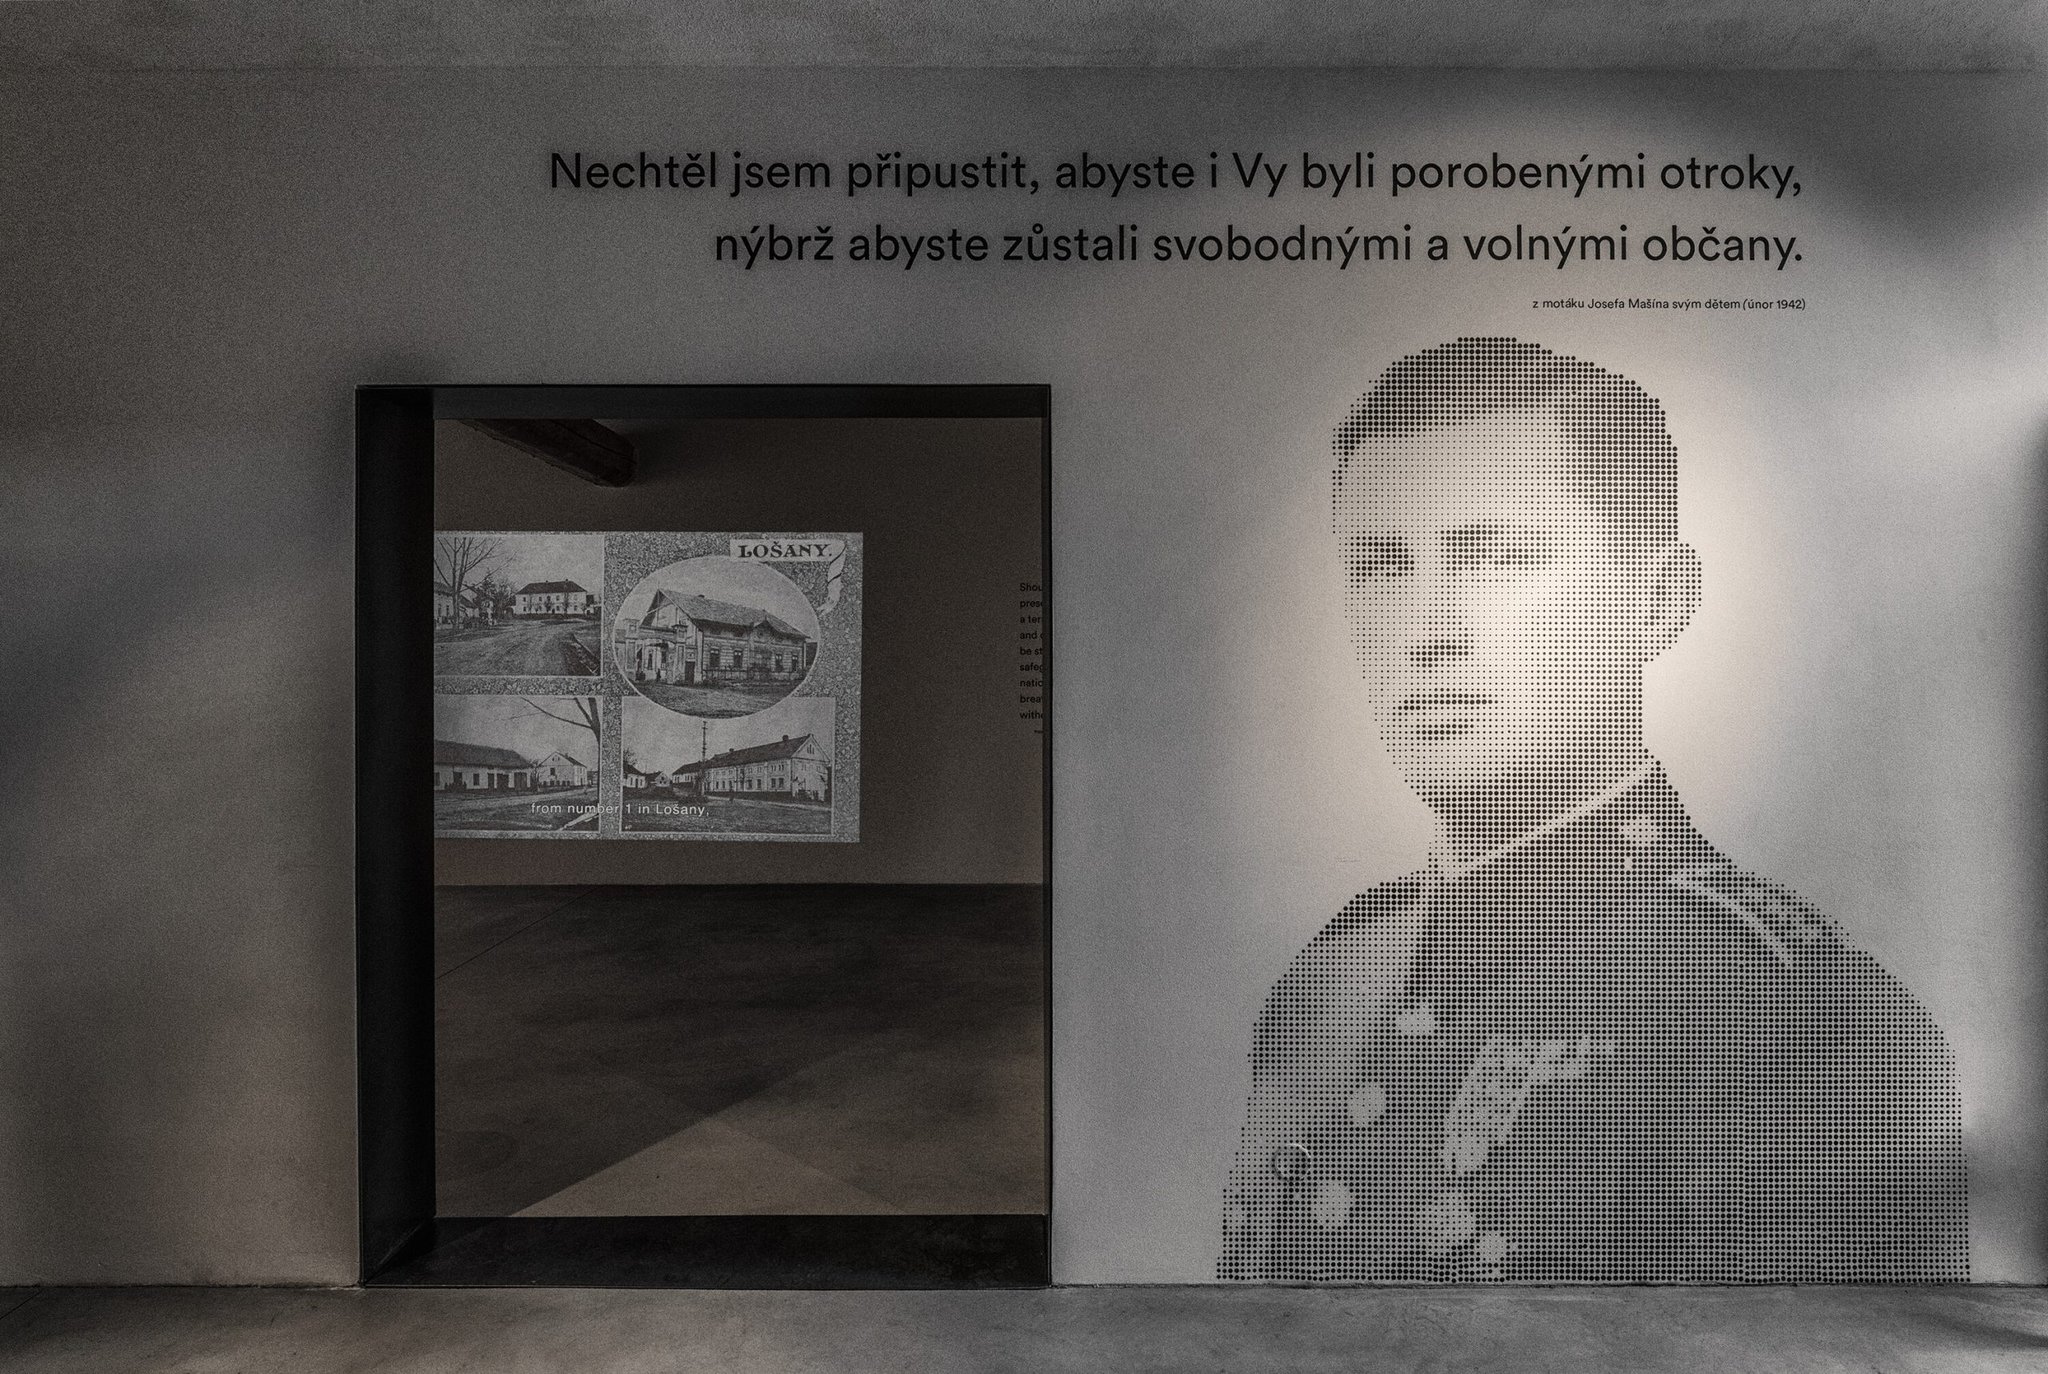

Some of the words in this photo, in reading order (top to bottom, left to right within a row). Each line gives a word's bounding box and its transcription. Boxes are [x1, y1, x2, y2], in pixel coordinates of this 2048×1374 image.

[551, 152, 716, 188] Nechtěl
[730, 152, 830, 197] jsem
[848, 152, 1039, 197] připustit,
[1055, 152, 1195, 197] abyste
[1209, 151, 1218, 188] i
[1232, 153, 1288, 197] Vy
[1303, 152, 1375, 197] byli
[1392, 152, 1645, 198] porobenými
[1660, 153, 1801, 198] otroky,
[716, 225, 834, 270] nýbrž
[849, 225, 989, 270] abyste
[1003, 223, 1138, 262] zůstali
[1153, 224, 1412, 270] svobodnými
[1427, 234, 1449, 262] a
[1463, 224, 1628, 270] volnými
[1642, 224, 1803, 270] občany.
[1532, 300, 1539, 309] z
[1542, 298, 1585, 309] motáku
[1587, 298, 1625, 310] Josefa
[1628, 298, 1669, 309] Mašína
[1672, 299, 1701, 311] svým
[1704, 298, 1741, 309] dětem
[1743, 298, 1774, 311] (únor
[1776, 298, 1806, 311] 1942)
[738, 541, 832, 558] LOŠANY.
[1020, 631, 1038, 640] and
[1020, 694, 1042, 703] brea
[531, 802, 562, 814] from
[567, 802, 620, 814] number
[625, 803, 632, 814] 1
[638, 803, 650, 814] in
[656, 803, 709, 817] Lošany,
